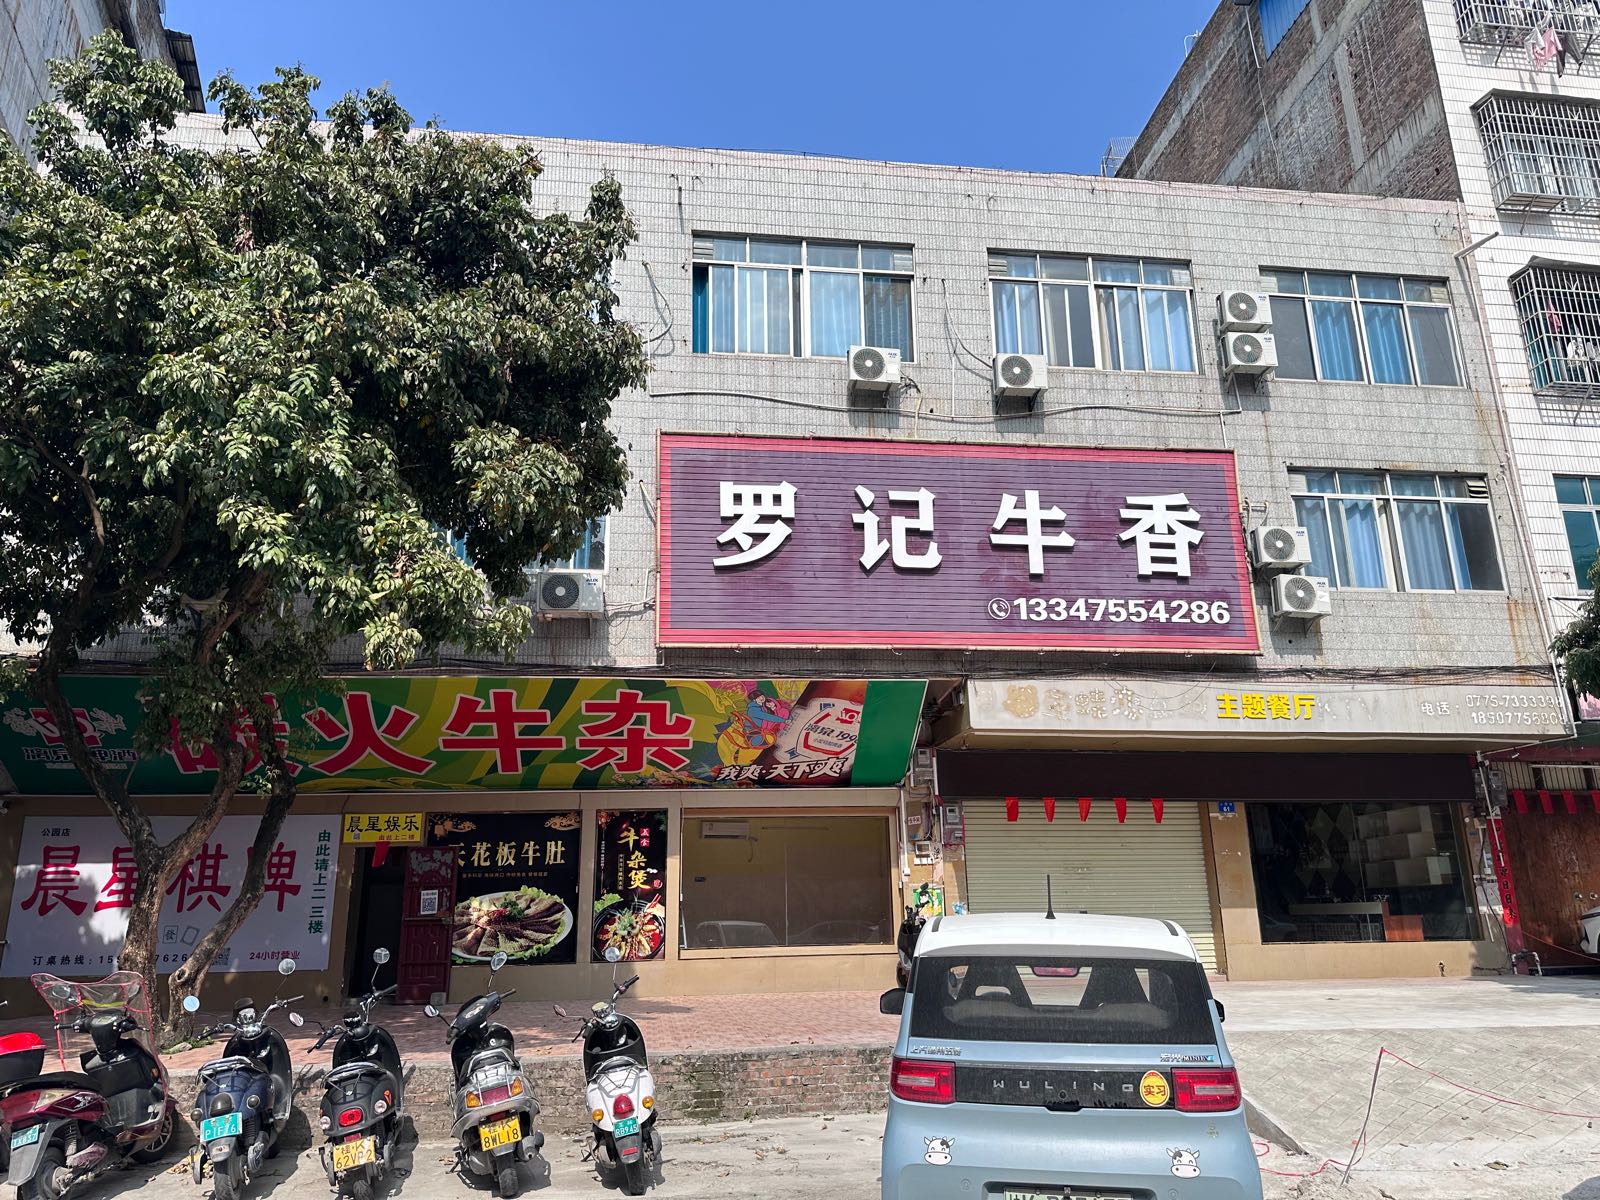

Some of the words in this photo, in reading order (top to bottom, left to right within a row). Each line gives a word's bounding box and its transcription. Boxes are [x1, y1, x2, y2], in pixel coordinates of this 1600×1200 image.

[712, 480, 1205, 578] 罗记牛香
[1012, 597, 1231, 625] 13347554286
[1216, 692, 1316, 720] 主题餐厅
[41, 827, 71, 837] 公园店
[346, 815, 419, 832] 晨星娱乐
[308, 829, 331, 935] 由此请上二三楼
[249, 951, 300, 961] 24小时营业
[993, 1079, 1134, 1093] WULING
[1143, 1084, 1167, 1097] 实习
